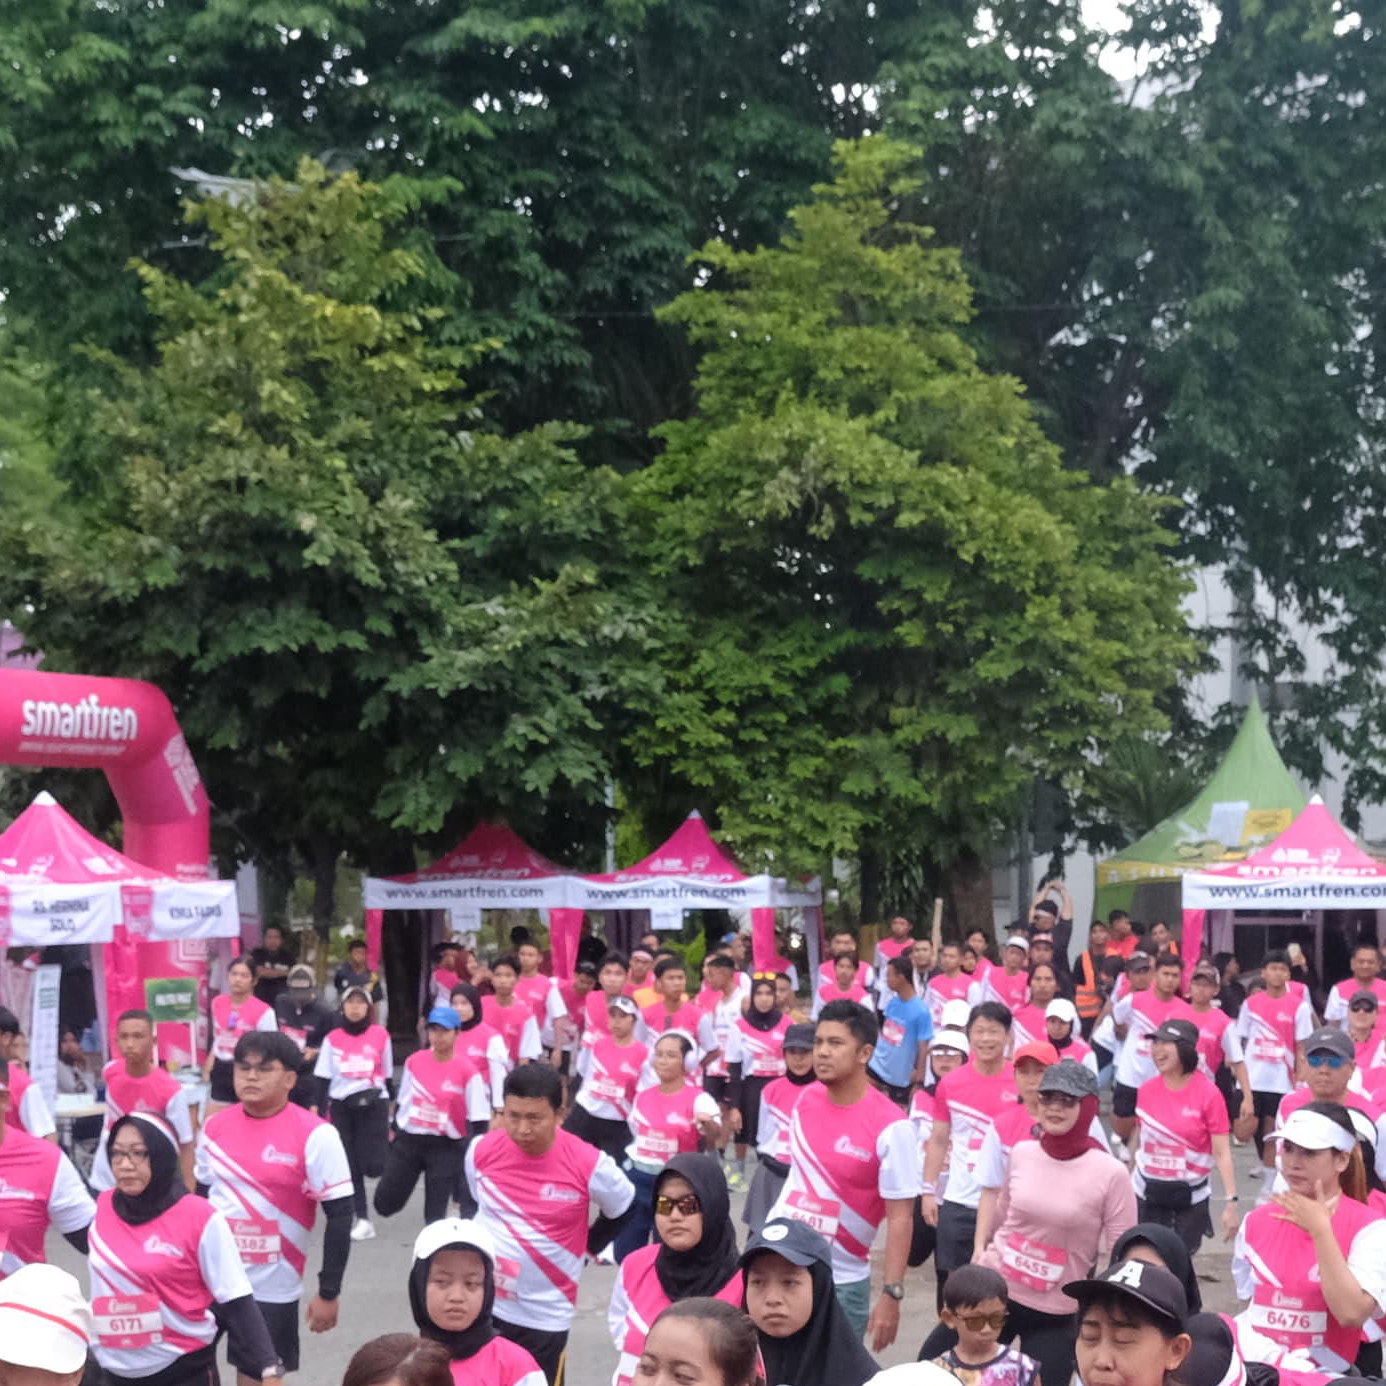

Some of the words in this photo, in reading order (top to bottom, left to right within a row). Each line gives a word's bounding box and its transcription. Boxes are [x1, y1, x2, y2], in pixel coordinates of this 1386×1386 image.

[21, 694, 138, 740] smartfren
[386, 884, 544, 900] www.smartfren.com
[587, 885, 746, 900] www.smartfren.com
[1015, 1256, 1049, 1278] 6455
[1109, 1259, 1145, 1289] A
[109, 1315, 143, 1331] 6171
[1267, 1311, 1311, 1329] 6476
